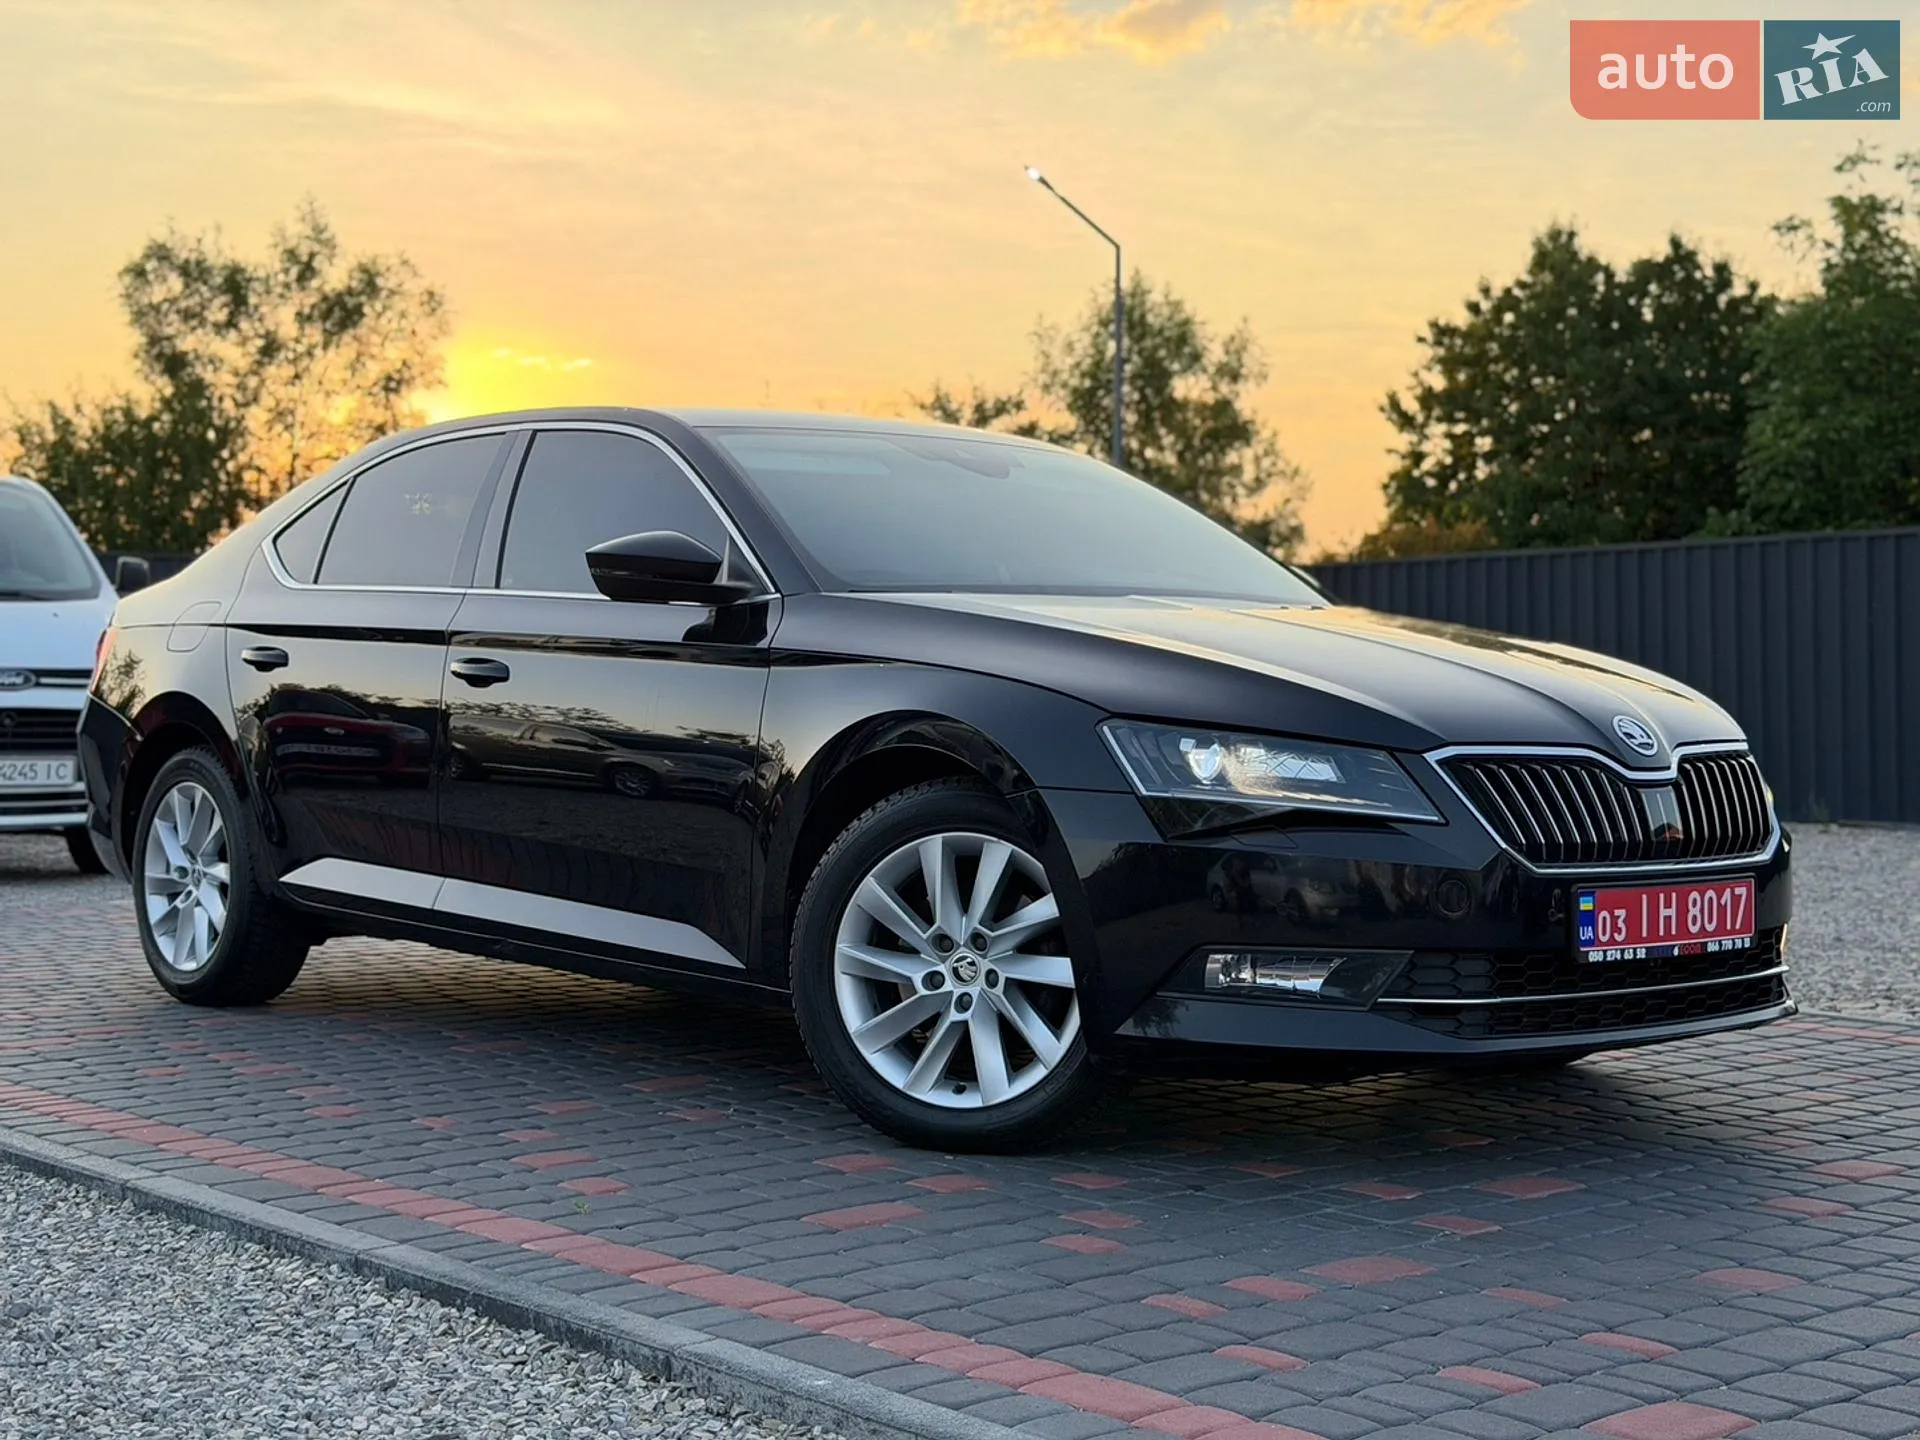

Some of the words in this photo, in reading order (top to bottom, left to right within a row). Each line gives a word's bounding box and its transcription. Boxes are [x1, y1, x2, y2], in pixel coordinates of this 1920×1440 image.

[1597, 909, 1627, 942] 03
[1687, 886, 1747, 934] 8017
[1579, 926, 1594, 940] UA
